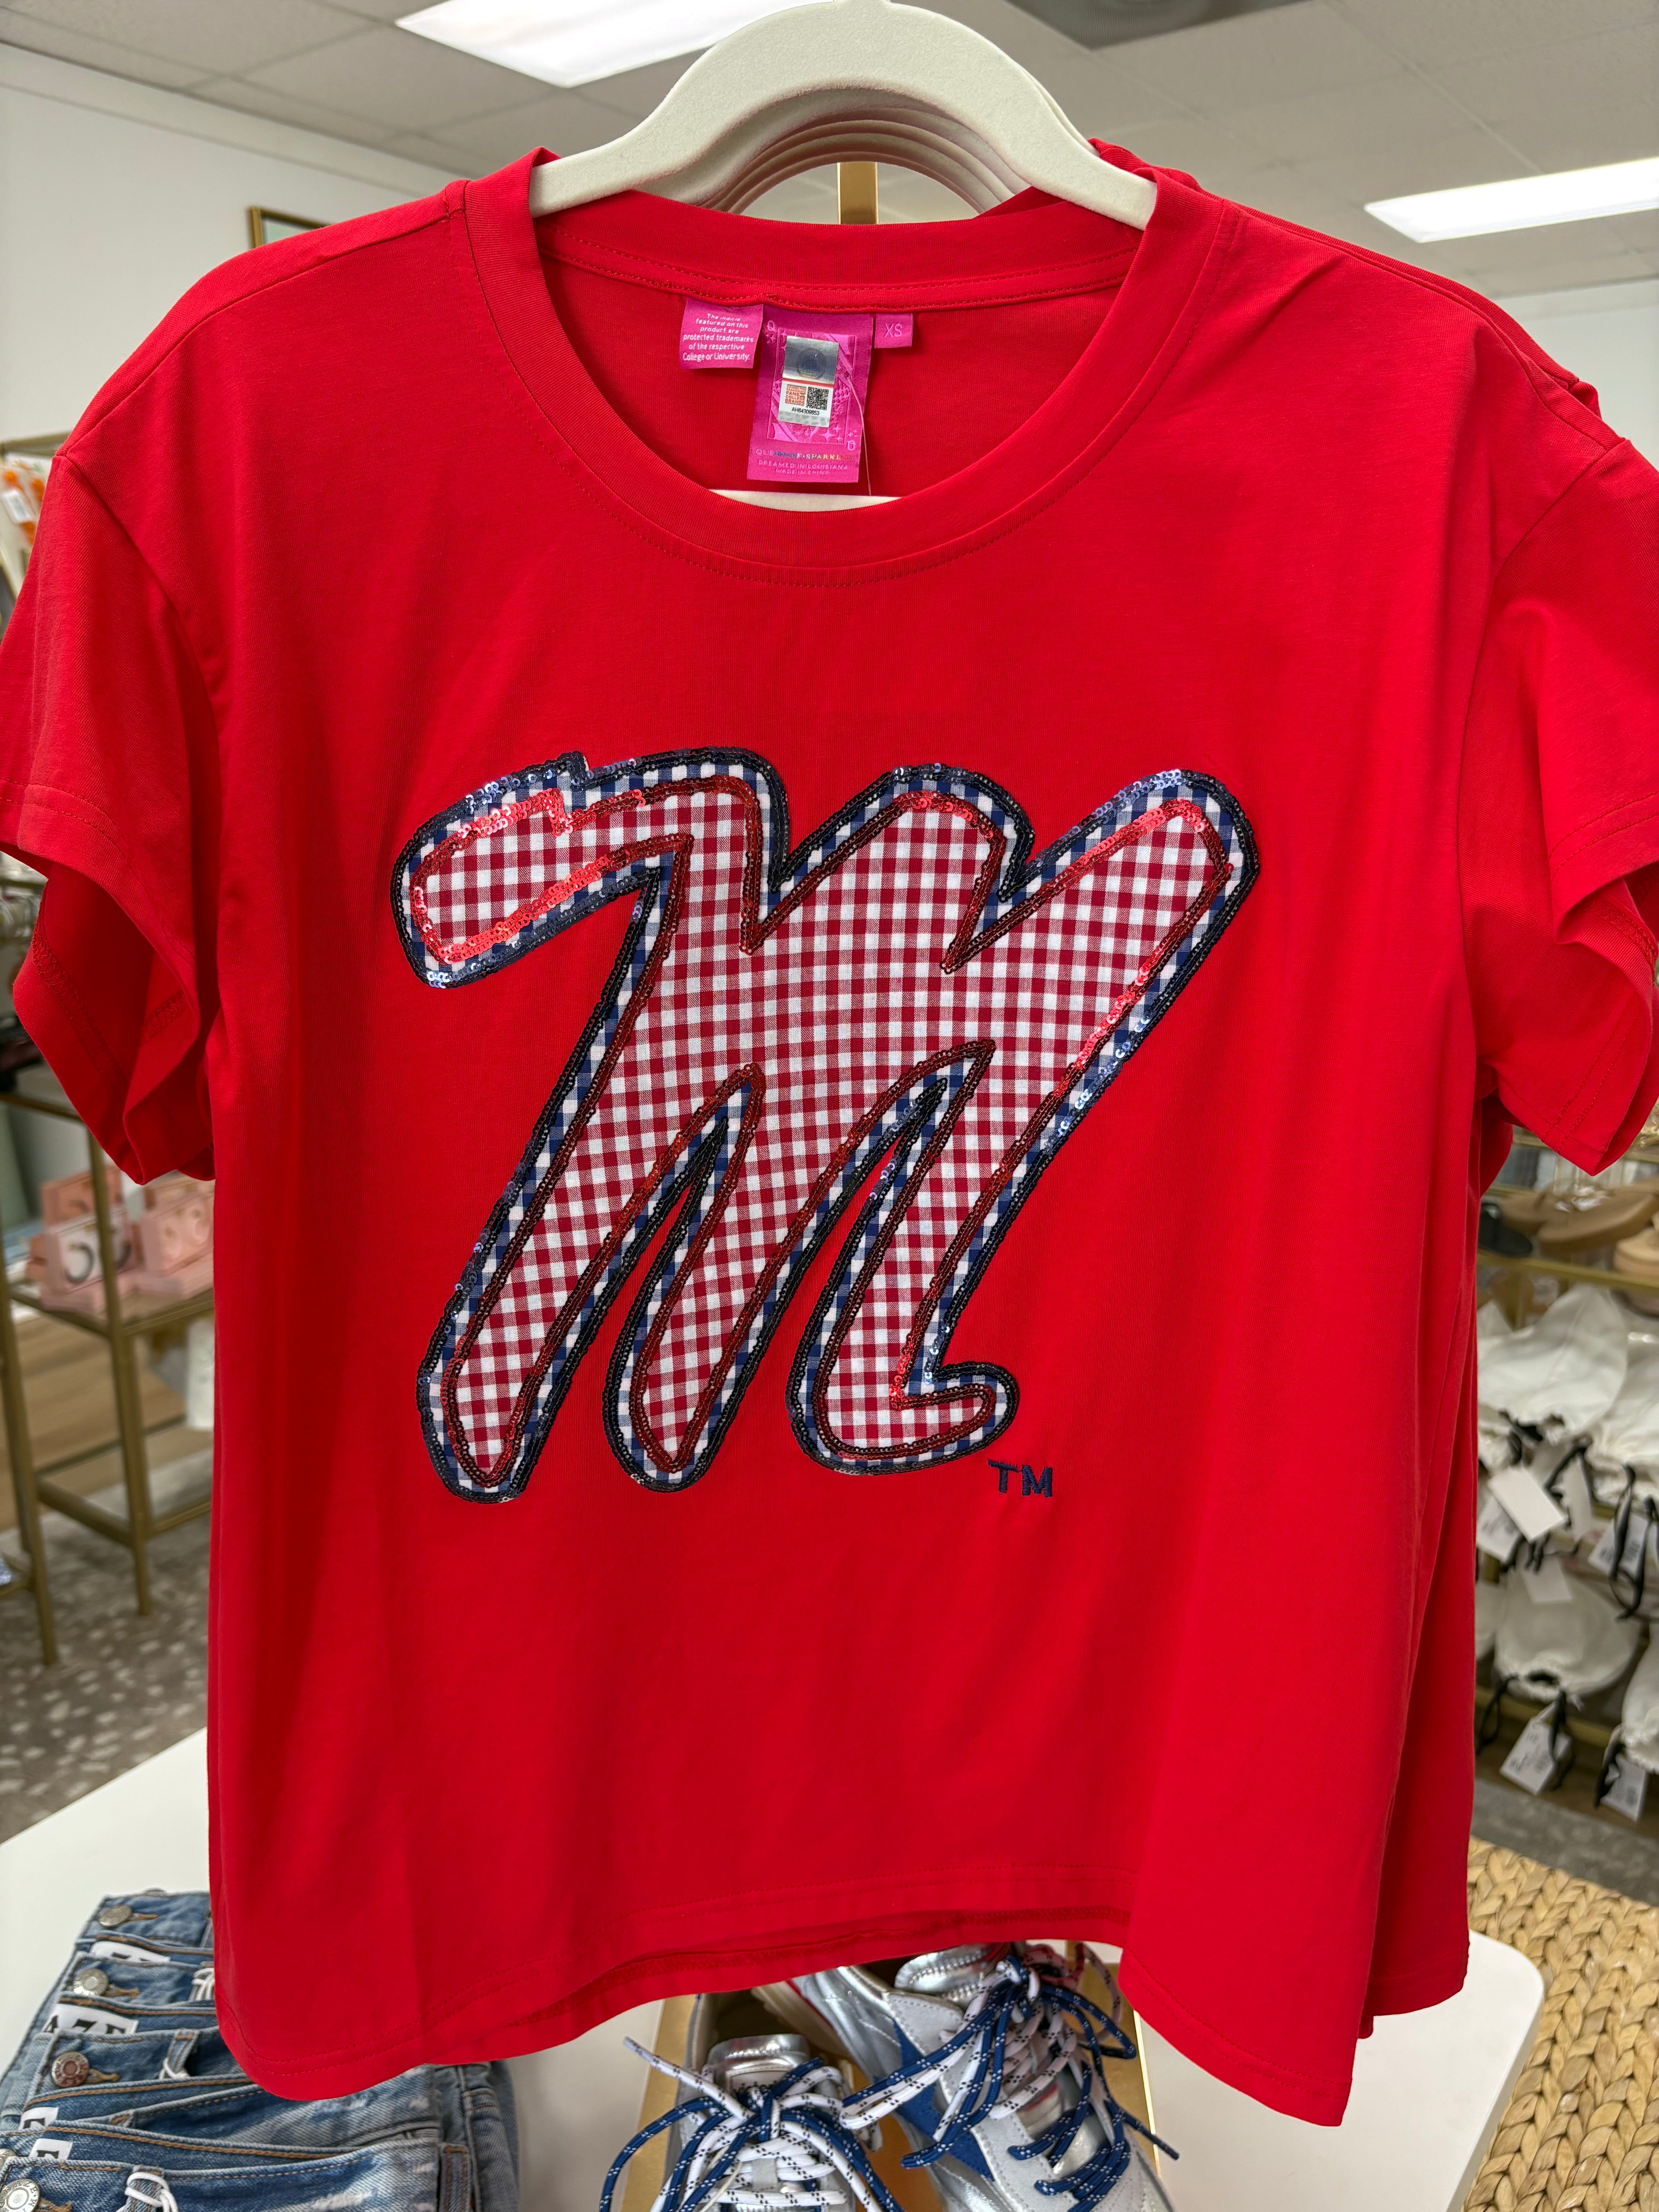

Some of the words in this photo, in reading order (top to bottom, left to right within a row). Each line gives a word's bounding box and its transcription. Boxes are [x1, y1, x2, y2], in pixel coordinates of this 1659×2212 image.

[696, 318, 725, 326] featured
[884, 323, 903, 338] XS
[716, 334, 754, 343] trademarks
[683, 352, 705, 362] College
[714, 352, 750, 362] University.
[987, 1459, 1052, 1498] TM
